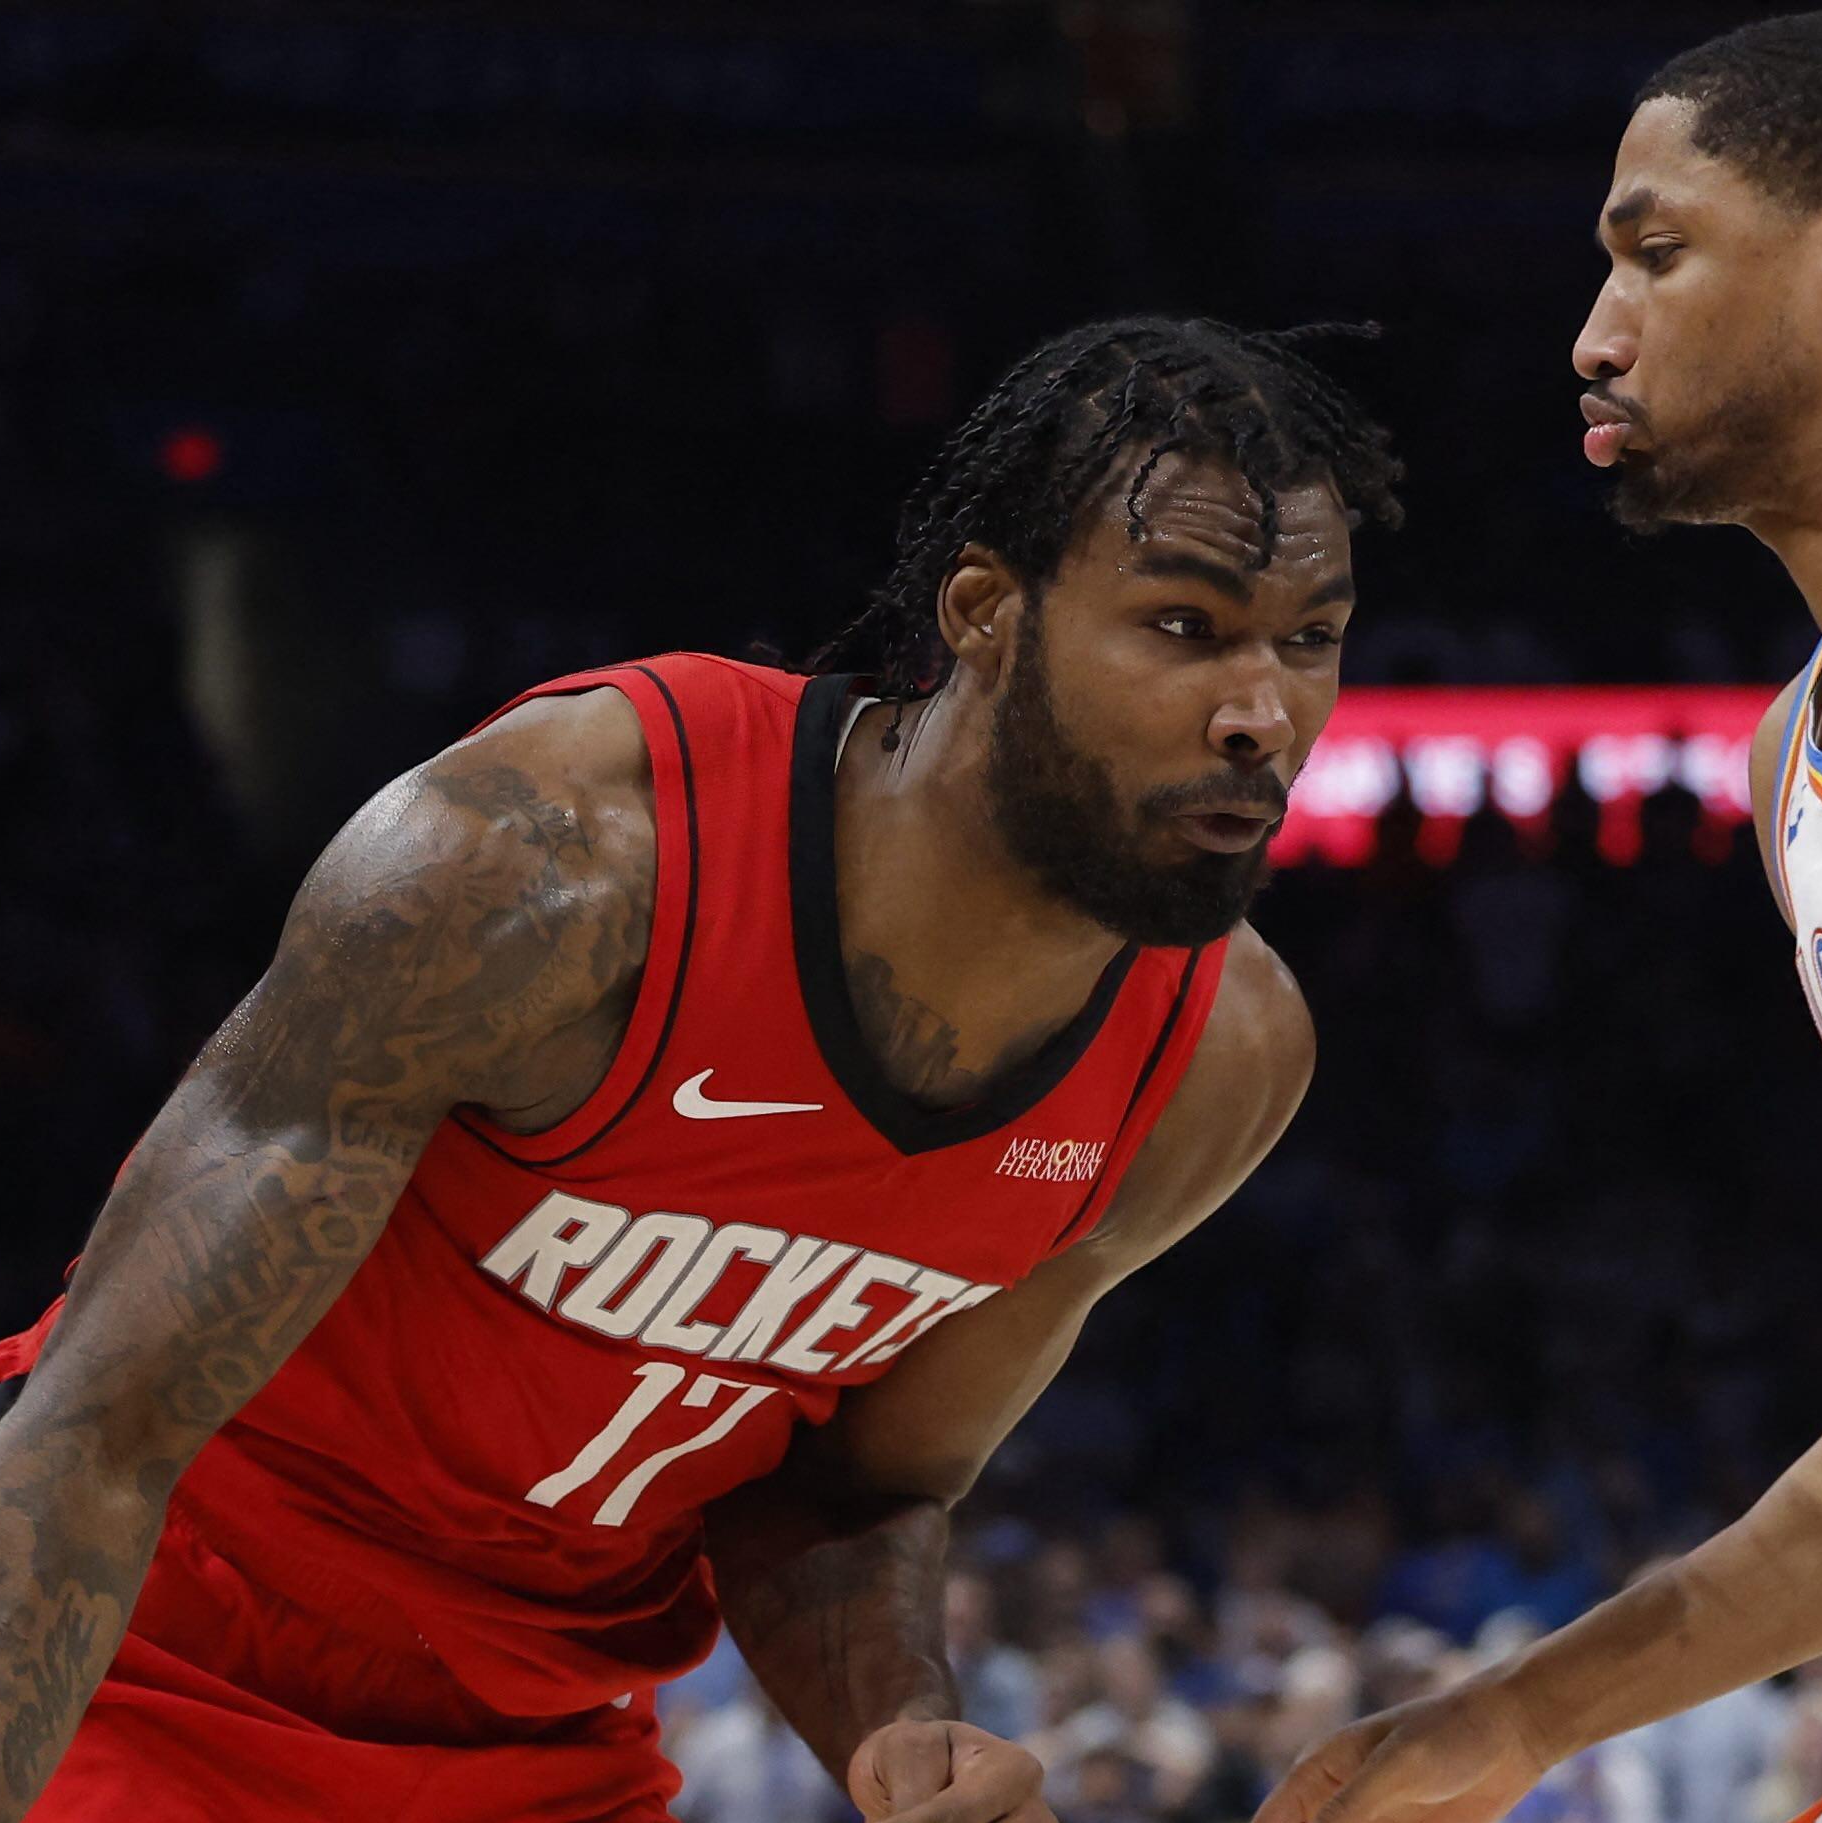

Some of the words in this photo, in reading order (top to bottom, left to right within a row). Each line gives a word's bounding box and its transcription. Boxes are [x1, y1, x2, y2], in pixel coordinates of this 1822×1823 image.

[1005, 1137, 1106, 1166] MEMORIAL
[994, 1155, 1100, 1182] HERMANN
[524, 1361, 780, 1527] 17
